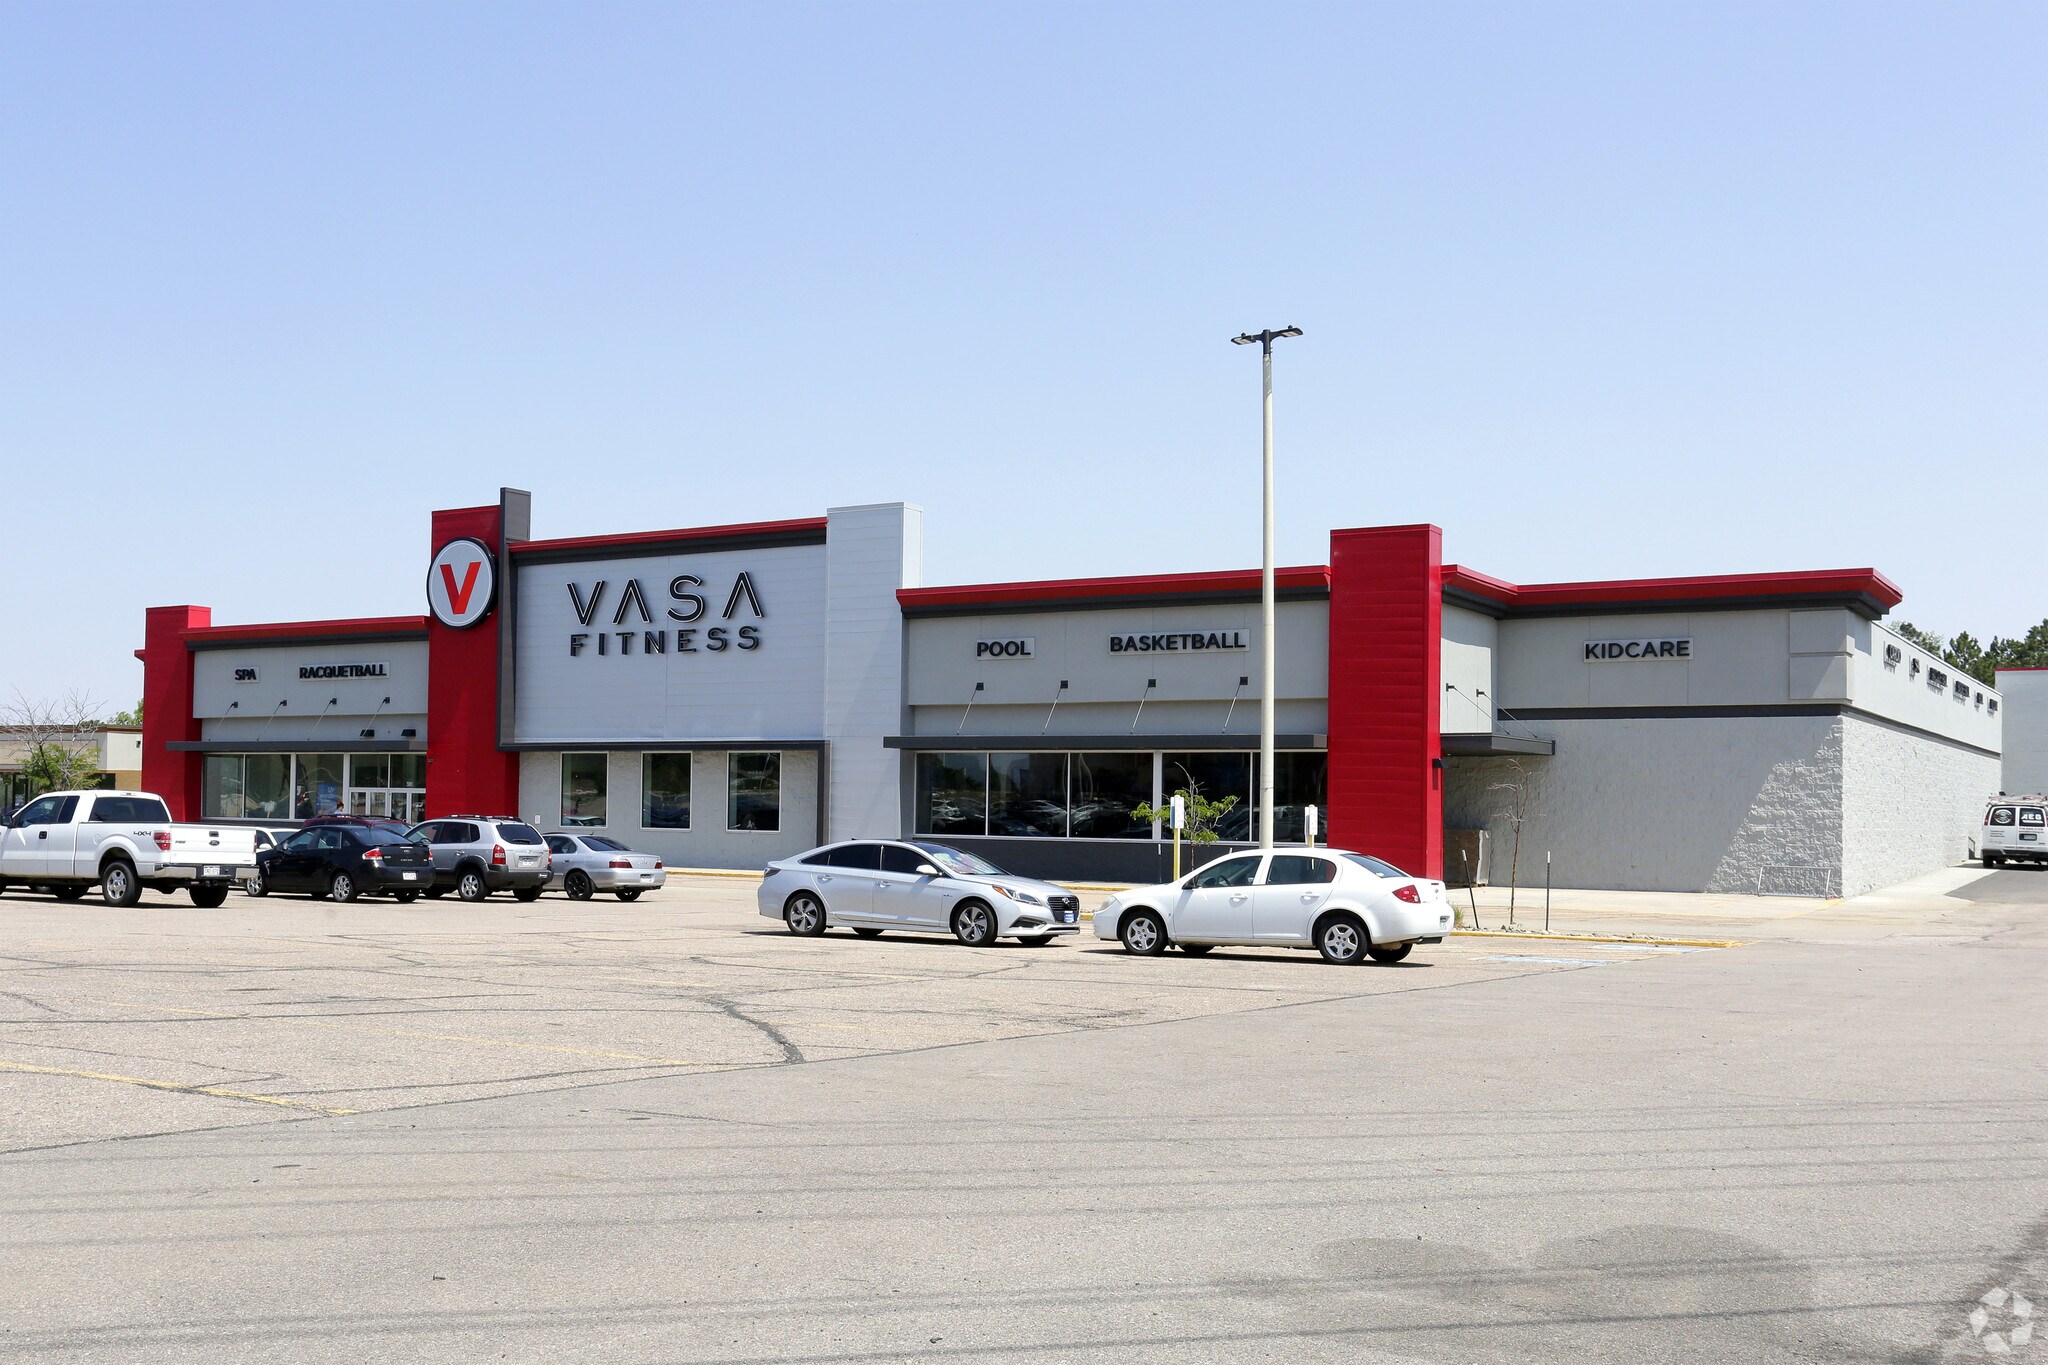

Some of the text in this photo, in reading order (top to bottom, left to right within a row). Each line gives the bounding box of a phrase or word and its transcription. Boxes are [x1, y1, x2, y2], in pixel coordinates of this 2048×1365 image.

[440, 562, 481, 614] V
[566, 571, 764, 626] VASA
[570, 625, 761, 656] FITNESS
[977, 640, 1031, 657] POOL
[1110, 632, 1246, 652] BASKETBALL
[1585, 640, 1690, 659] KIDCARE
[235, 669, 256, 680] SPA
[300, 664, 387, 678] RACQUETBALL
